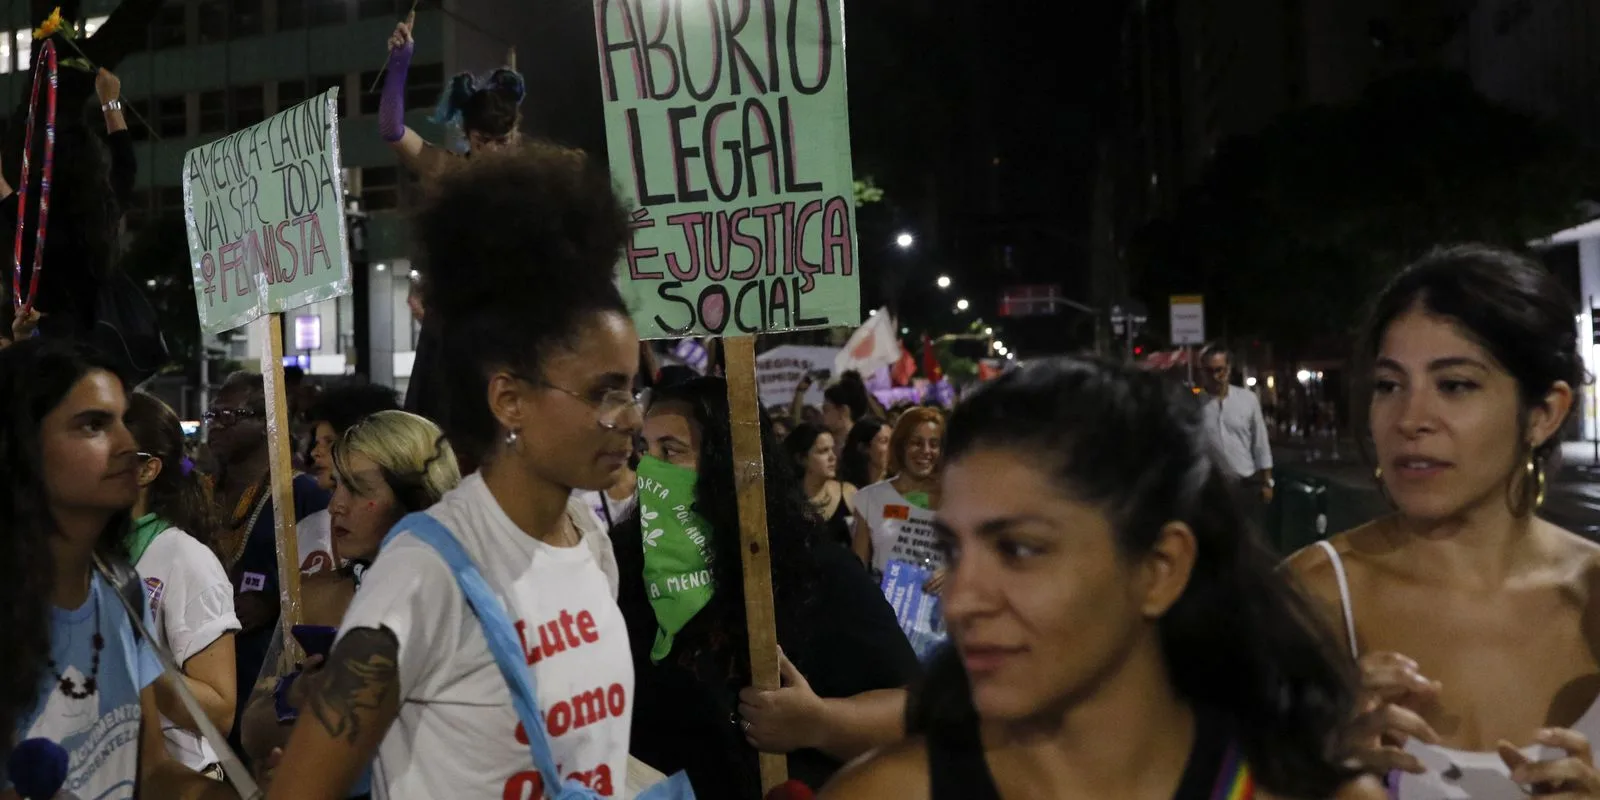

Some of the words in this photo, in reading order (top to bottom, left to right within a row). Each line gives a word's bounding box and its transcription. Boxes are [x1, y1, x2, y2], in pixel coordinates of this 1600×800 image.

[594, 0, 832, 102] ABORTO
[625, 97, 823, 206] LEGAL
[194, 195, 229, 251] VAI
[229, 175, 270, 240] SER
[272, 154, 338, 219] TODA
[627, 208, 665, 280] É
[665, 195, 852, 293] JUSTIÇA
[654, 277, 829, 335] SOCIAL
[637, 476, 670, 499] ORTA
[650, 583, 660, 599] A
[514, 609, 600, 666] Lute
